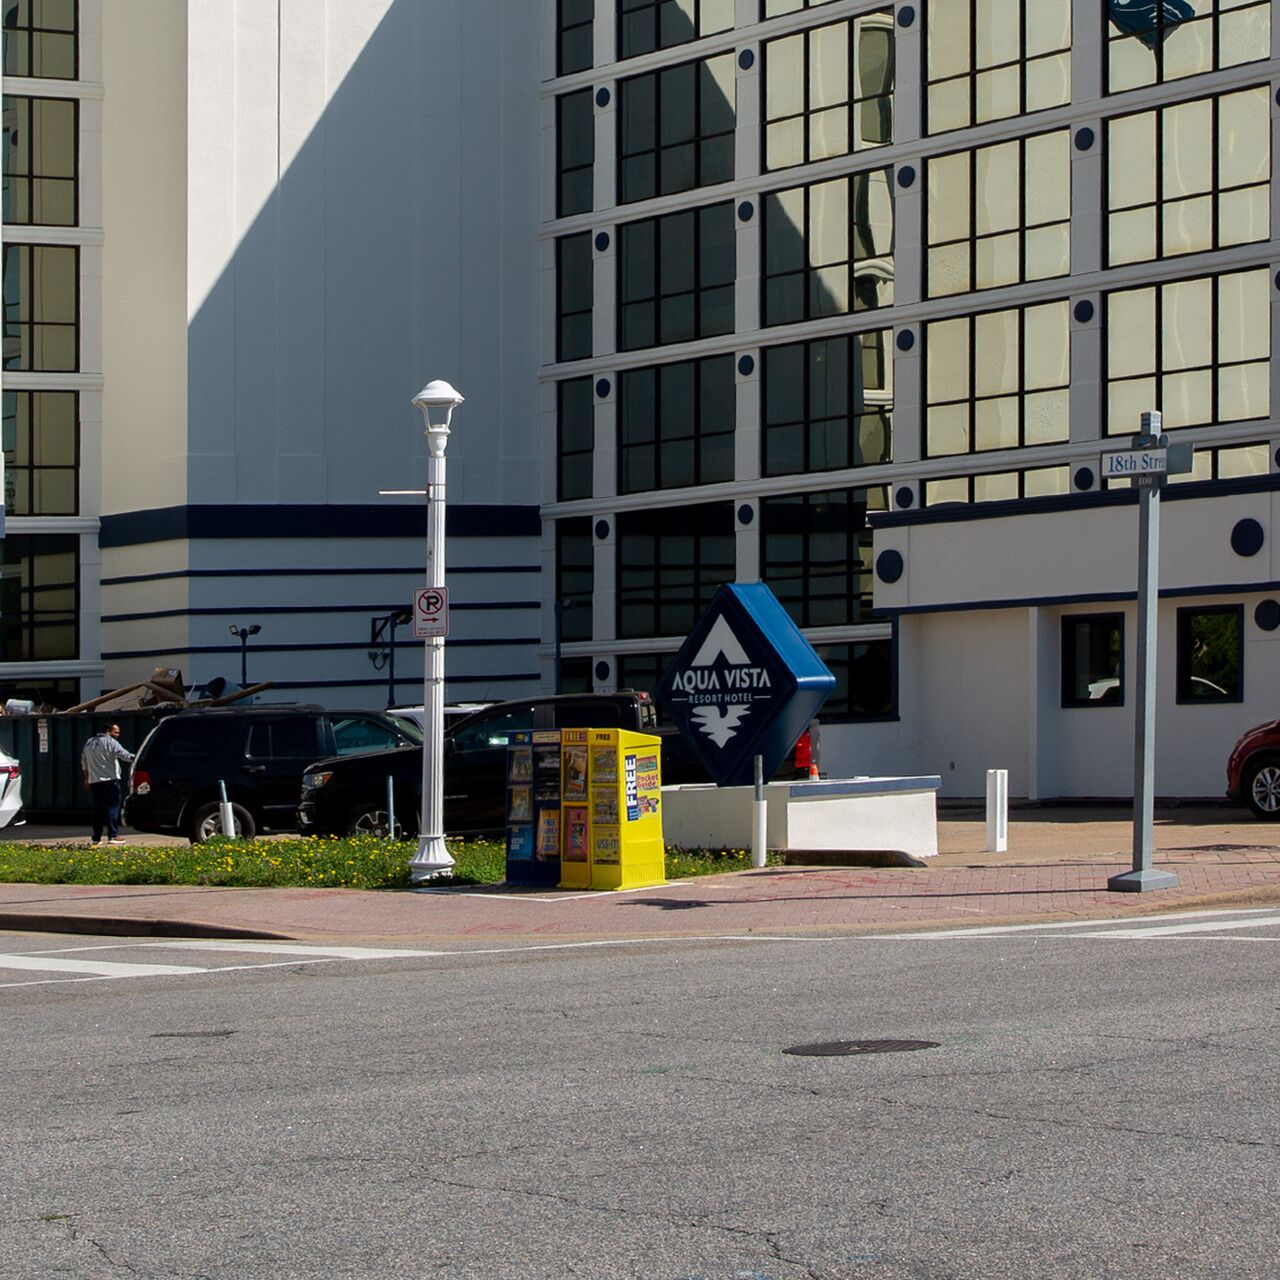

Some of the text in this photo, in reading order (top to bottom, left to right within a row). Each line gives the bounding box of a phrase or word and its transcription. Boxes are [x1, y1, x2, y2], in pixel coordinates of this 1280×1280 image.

[1108, 454, 1137, 473] 18th
[671, 667, 772, 695] AQUA VISTA
[688, 692, 753, 704] RESORT HOTEL
[625, 757, 637, 807] FREE
